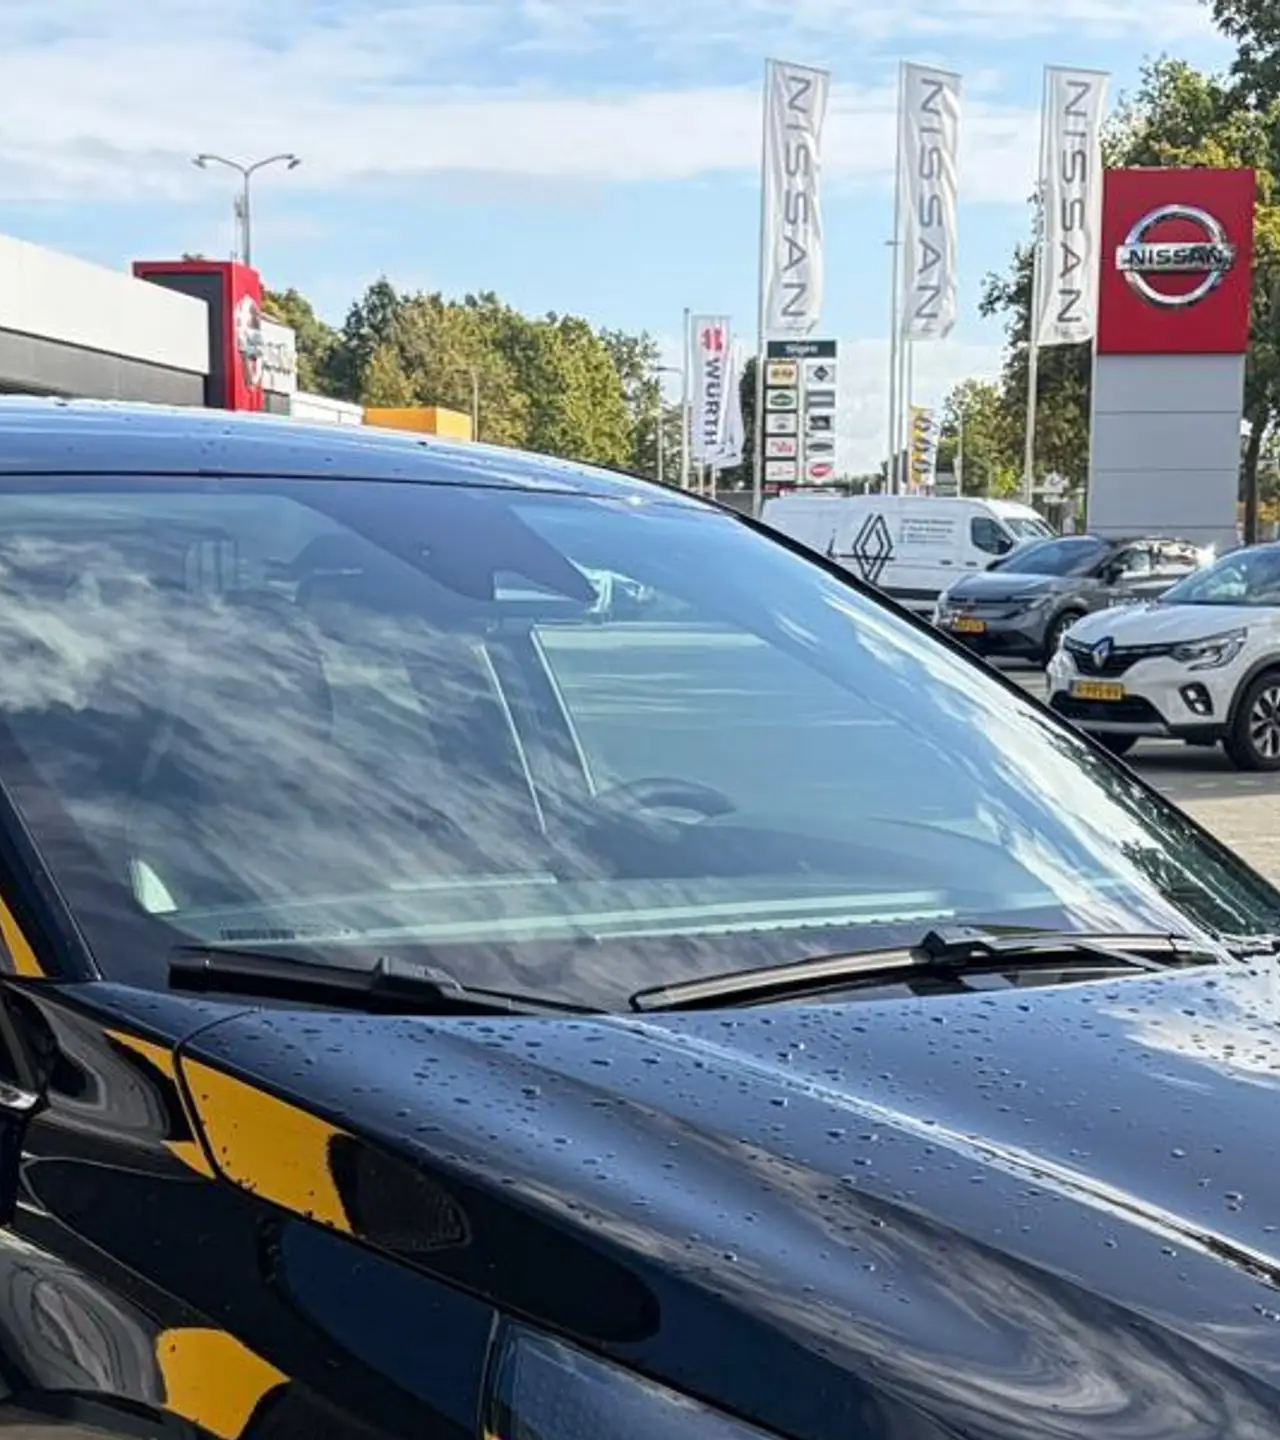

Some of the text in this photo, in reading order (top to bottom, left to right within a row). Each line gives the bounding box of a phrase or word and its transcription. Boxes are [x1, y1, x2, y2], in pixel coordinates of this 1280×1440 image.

[781, 75, 811, 318] NISSAN
[915, 78, 944, 320] NISSAN
[1057, 80, 1091, 323] NISSAN
[1129, 245, 1223, 266] NISSAN
